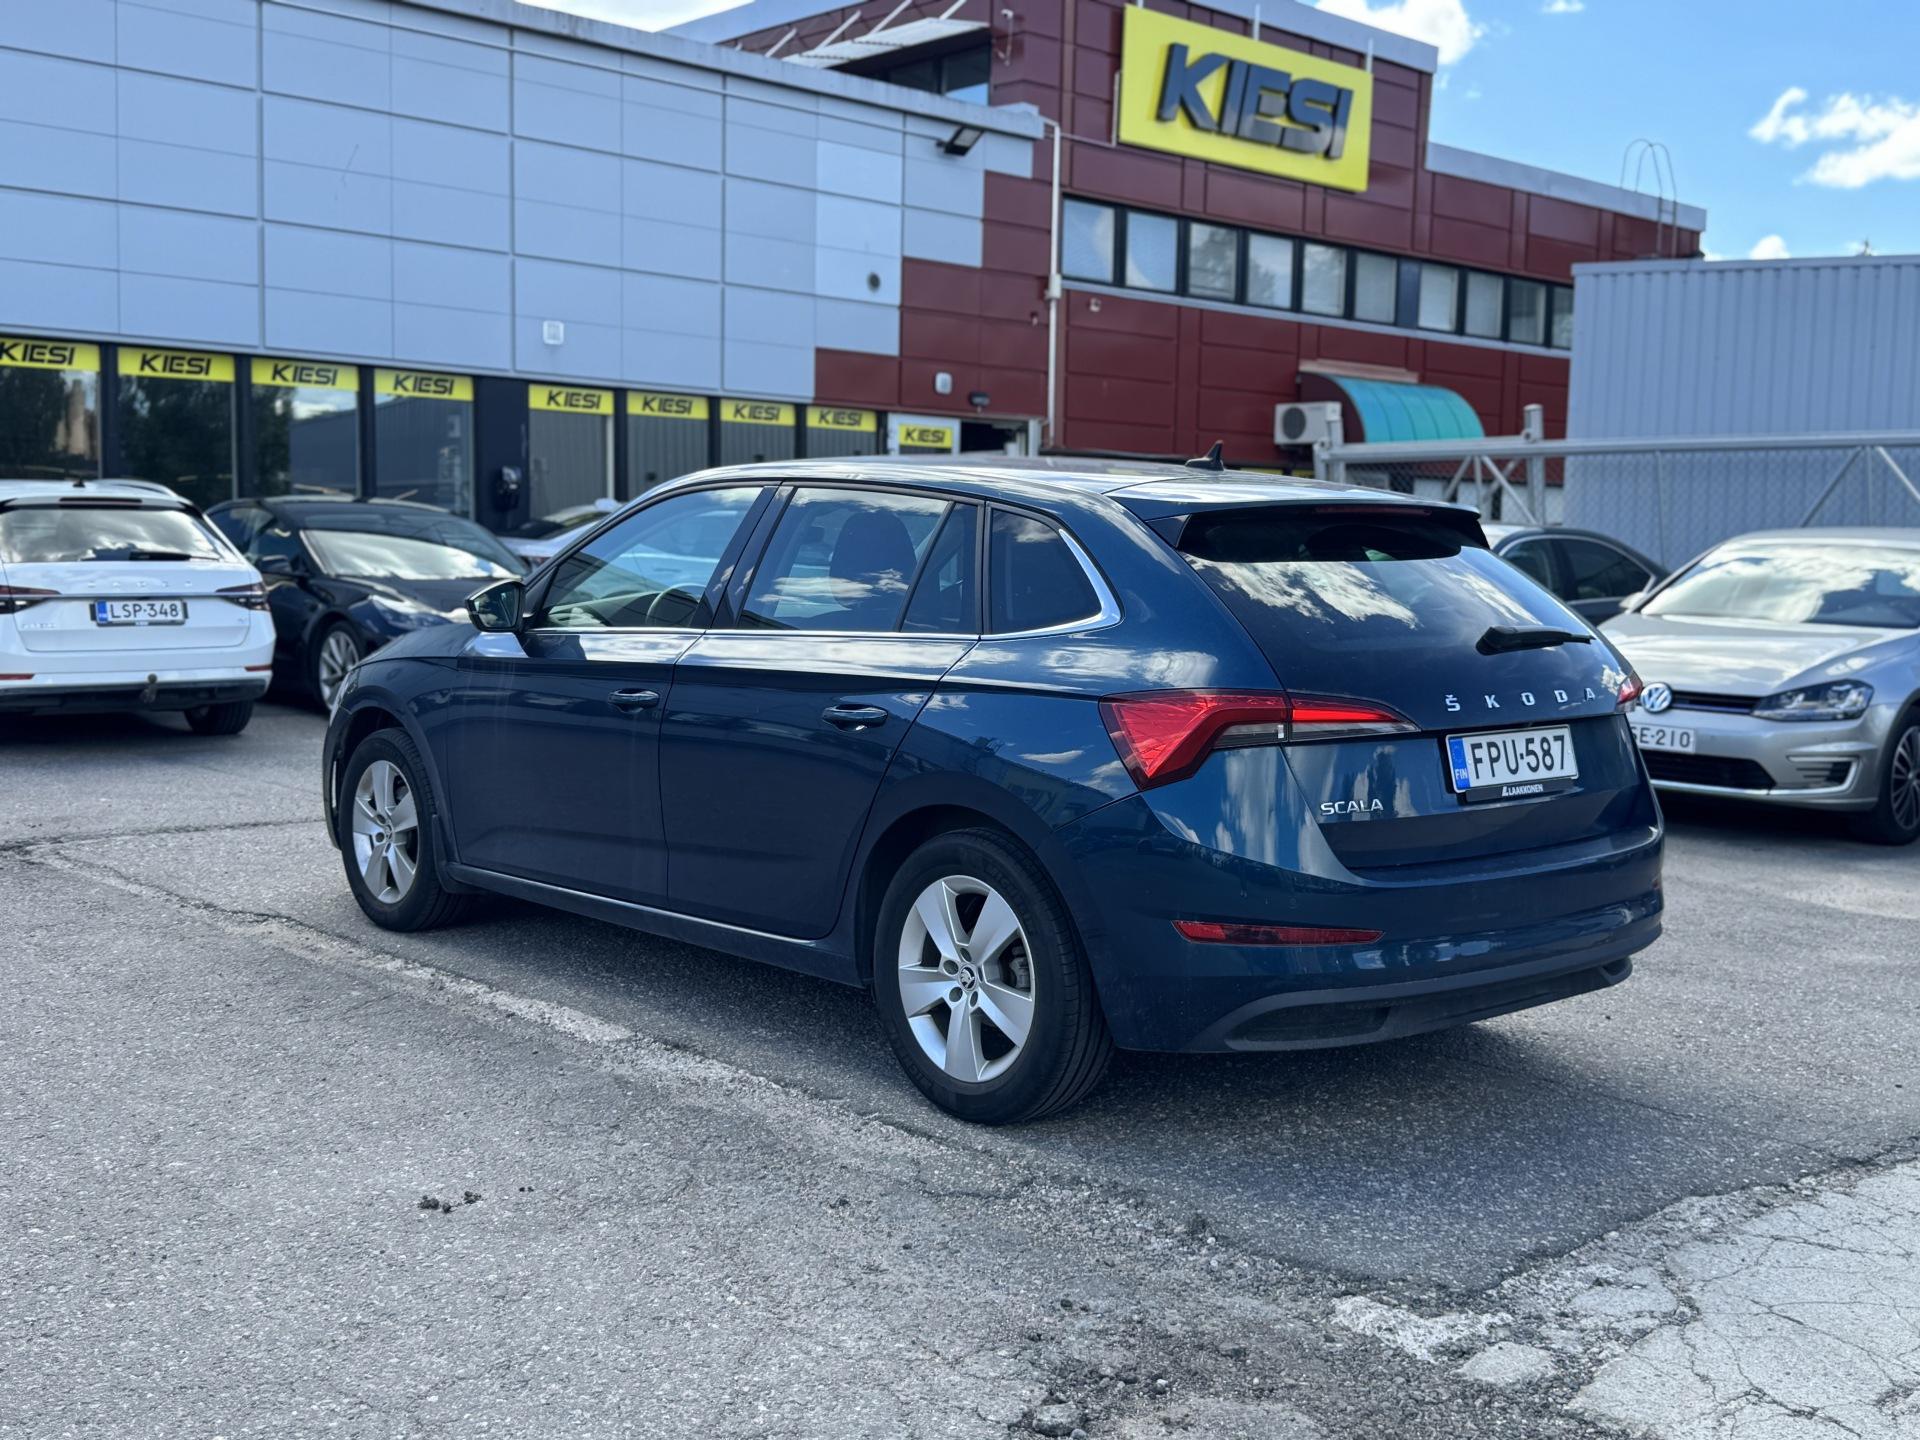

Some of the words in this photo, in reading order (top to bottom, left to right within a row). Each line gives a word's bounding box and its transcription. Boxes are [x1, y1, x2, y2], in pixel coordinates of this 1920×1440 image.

[1156, 42, 1354, 160] KIESI
[0, 341, 76, 366] KIESI
[139, 352, 212, 376] KIESI
[271, 363, 339, 386] KIESI
[393, 373, 455, 395] KIESI
[546, 389, 602, 410] KIESI
[641, 396, 693, 415] KIESI
[733, 404, 781, 422] KIESI
[818, 410, 862, 427] KIESI
[904, 428, 946, 443] KIESI
[110, 603, 179, 618] LSP-348
[1445, 688, 1596, 712] ŠKODA
[1470, 735, 1566, 779] FPU-587
[1454, 768, 1468, 780] FIN
[1321, 798, 1384, 815] SCALA
